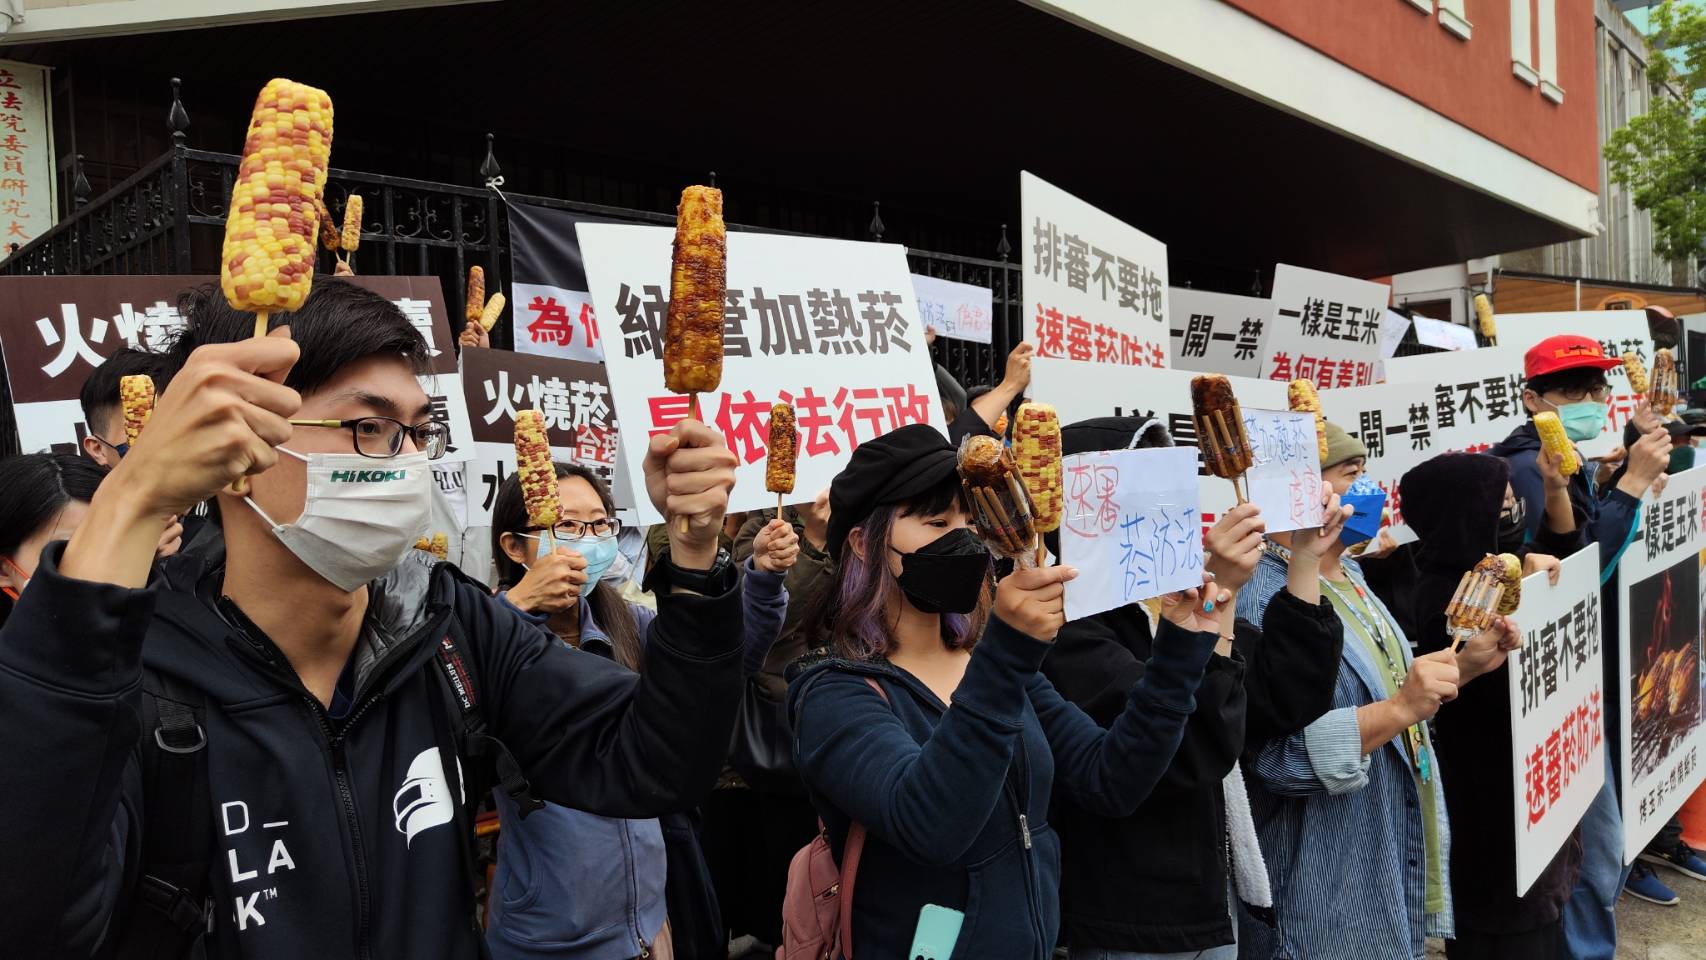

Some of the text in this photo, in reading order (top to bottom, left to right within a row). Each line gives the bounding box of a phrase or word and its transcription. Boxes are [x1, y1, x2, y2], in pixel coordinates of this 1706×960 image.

[1033, 216, 1163, 322] 排審不要拖
[1170, 313, 1263, 361] 一開一禁
[1278, 297, 1380, 345] 一樣是玉米
[483, 371, 619, 432] 火燒菸
[330, 469, 406, 483] HiKOKI
[1630, 491, 1698, 562] 一樣是玉米
[1519, 592, 1598, 718] 排審不要拖
[1525, 684, 1601, 832] 速審菸防法
